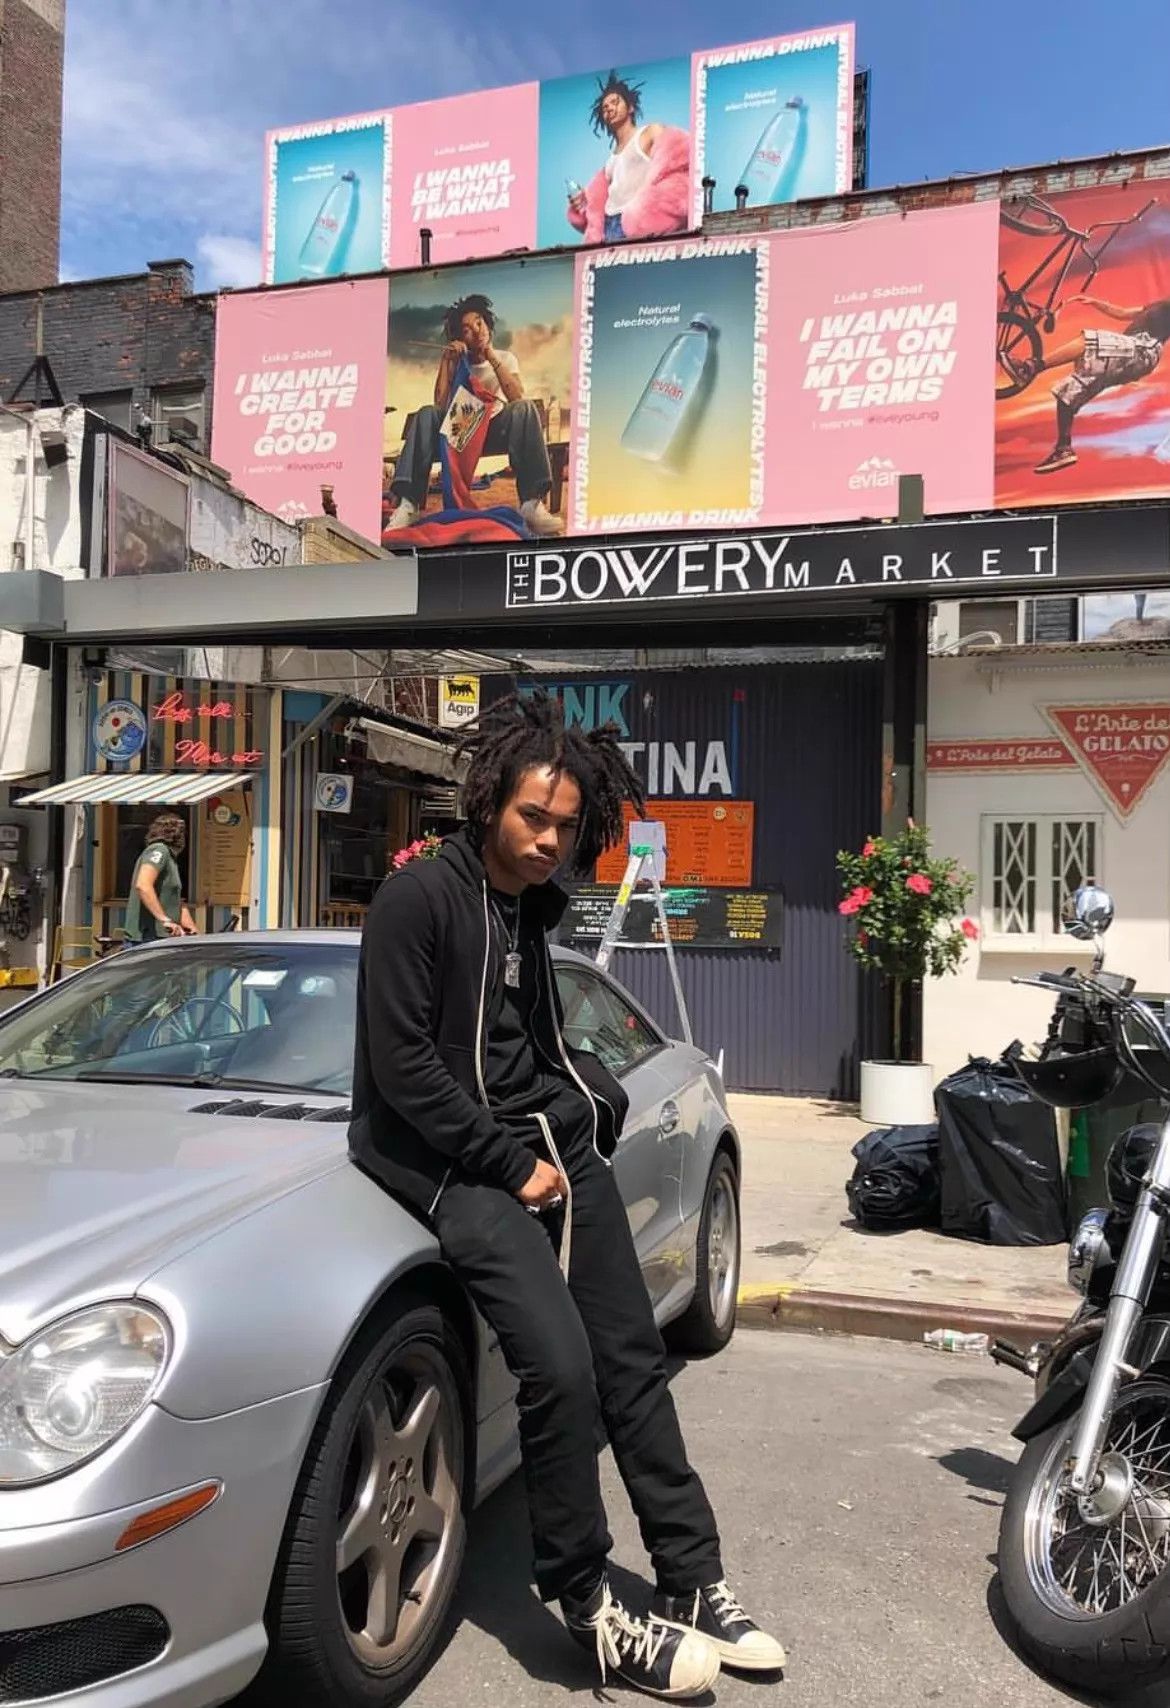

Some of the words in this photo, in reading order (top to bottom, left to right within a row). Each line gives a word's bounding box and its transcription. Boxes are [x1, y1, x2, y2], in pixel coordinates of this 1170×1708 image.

[707, 45, 775, 67] WANNA
[777, 33, 838, 55] DRINK
[413, 172, 424, 190] I
[427, 158, 511, 188] WANNA
[411, 188, 443, 206] BE
[446, 174, 516, 201] WHAT
[412, 205, 423, 223] I
[425, 192, 511, 220] WANNA
[594, 246, 678, 269] WANNA
[680, 239, 757, 261] DRINK
[753, 239, 770, 342] NATURAL
[833, 291, 868, 305] Luka
[872, 283, 924, 299] Sabbat
[613, 314, 681, 329] electrolytes
[638, 303, 681, 316] Natural
[800, 318, 815, 342] I
[819, 301, 958, 339] WANNA
[578, 267, 595, 432] ELECTROLYTES
[806, 335, 888, 365] FAIL
[897, 326, 955, 354] ON
[234, 374, 247, 395] I
[251, 363, 359, 392] WANNA
[802, 360, 862, 390] MY
[865, 351, 957, 382] OWN
[239, 386, 358, 415] CREATE
[651, 378, 685, 401] evian
[816, 377, 945, 412] TERMS
[265, 411, 326, 434] FOR
[750, 342, 769, 512] ELECTROLYTES
[254, 431, 337, 457] GOOD
[575, 438, 589, 531] NATURAL
[600, 511, 683, 530] WANNA
[686, 505, 761, 525] DRINK
[513, 555, 530, 603] THE
[534, 537, 790, 602] BOWERY
[784, 547, 1049, 588] MARKET
[447, 702, 475, 717] Agip
[1075, 713, 1141, 732] L'Arte
[1083, 735, 1170, 752] GELATO
